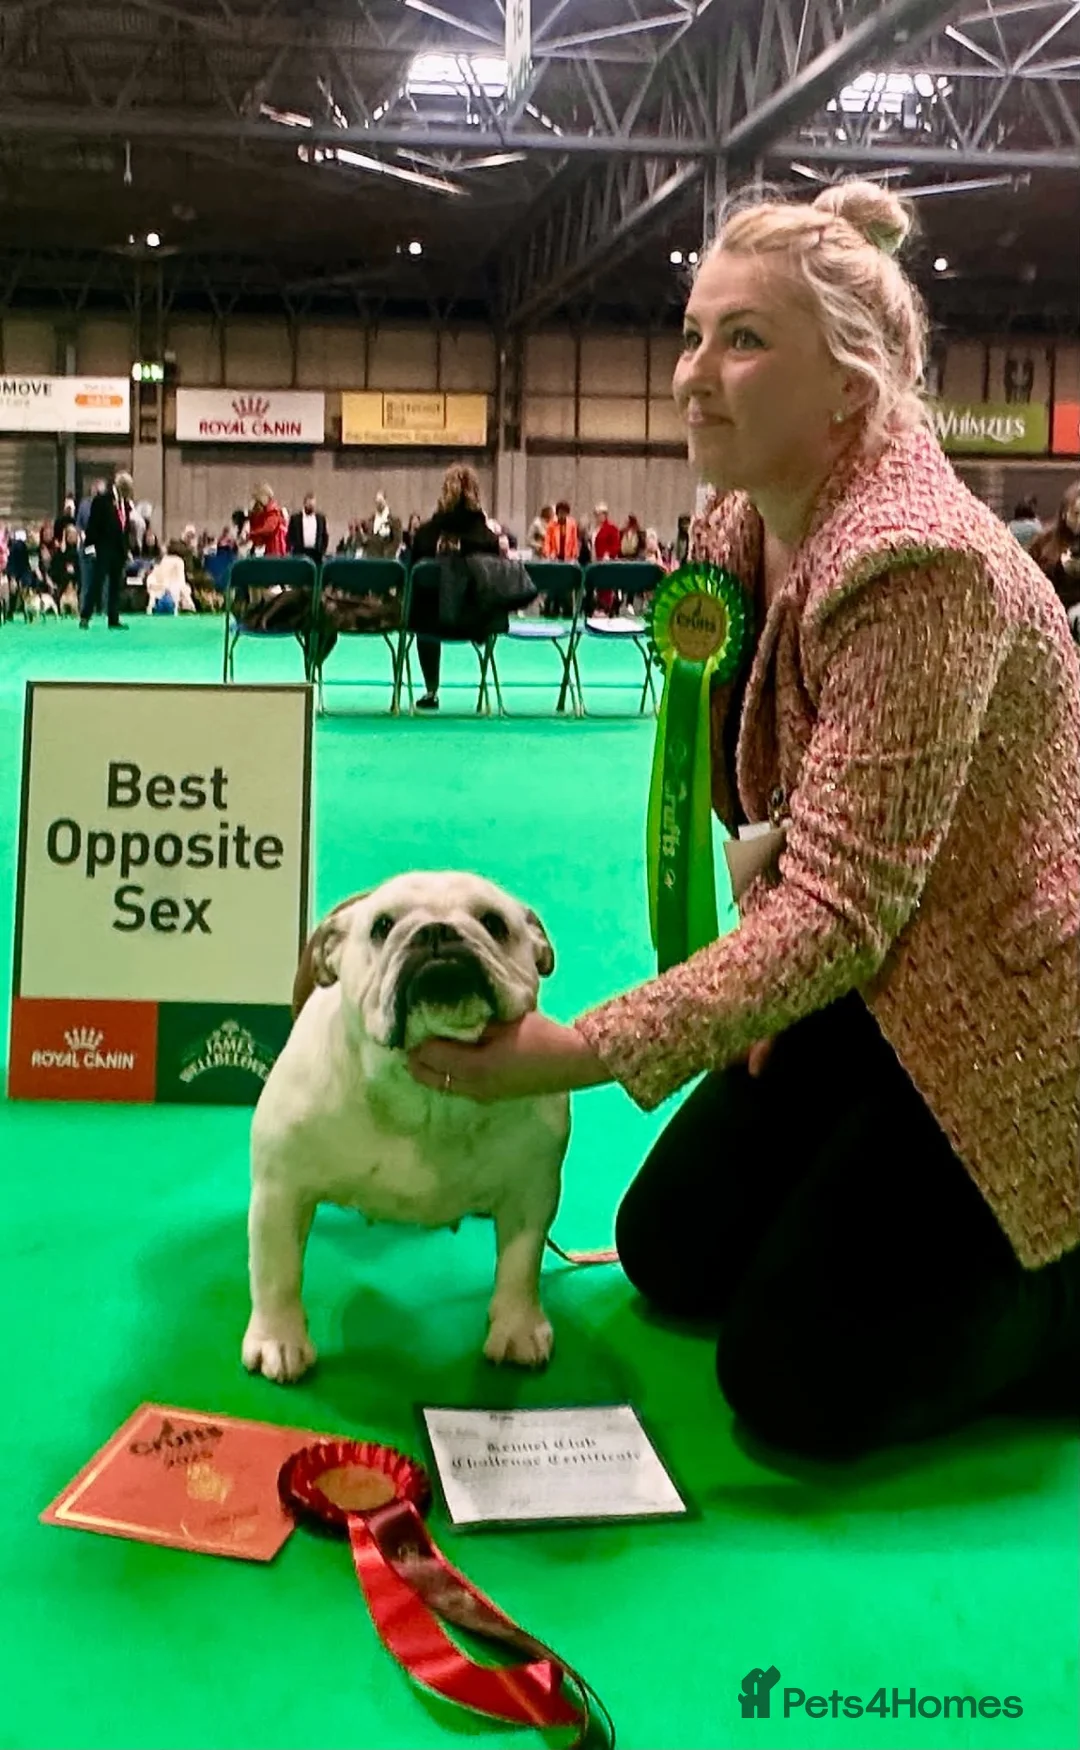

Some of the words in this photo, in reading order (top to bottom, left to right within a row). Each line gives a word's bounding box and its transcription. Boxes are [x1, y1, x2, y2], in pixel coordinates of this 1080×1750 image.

[0, 379, 52, 397] MOVE
[199, 419, 249, 437] ROYAL
[251, 419, 302, 437] CANIN
[107, 761, 228, 811] Best
[46, 817, 284, 878] Opposite
[112, 884, 212, 935] Sex
[31, 1048, 80, 1069] ROYAL
[83, 1048, 135, 1070] CANIN
[554, 1437, 598, 1450] Club
[451, 1456, 542, 1470] Challenge
[547, 1450, 643, 1468] Certificate
